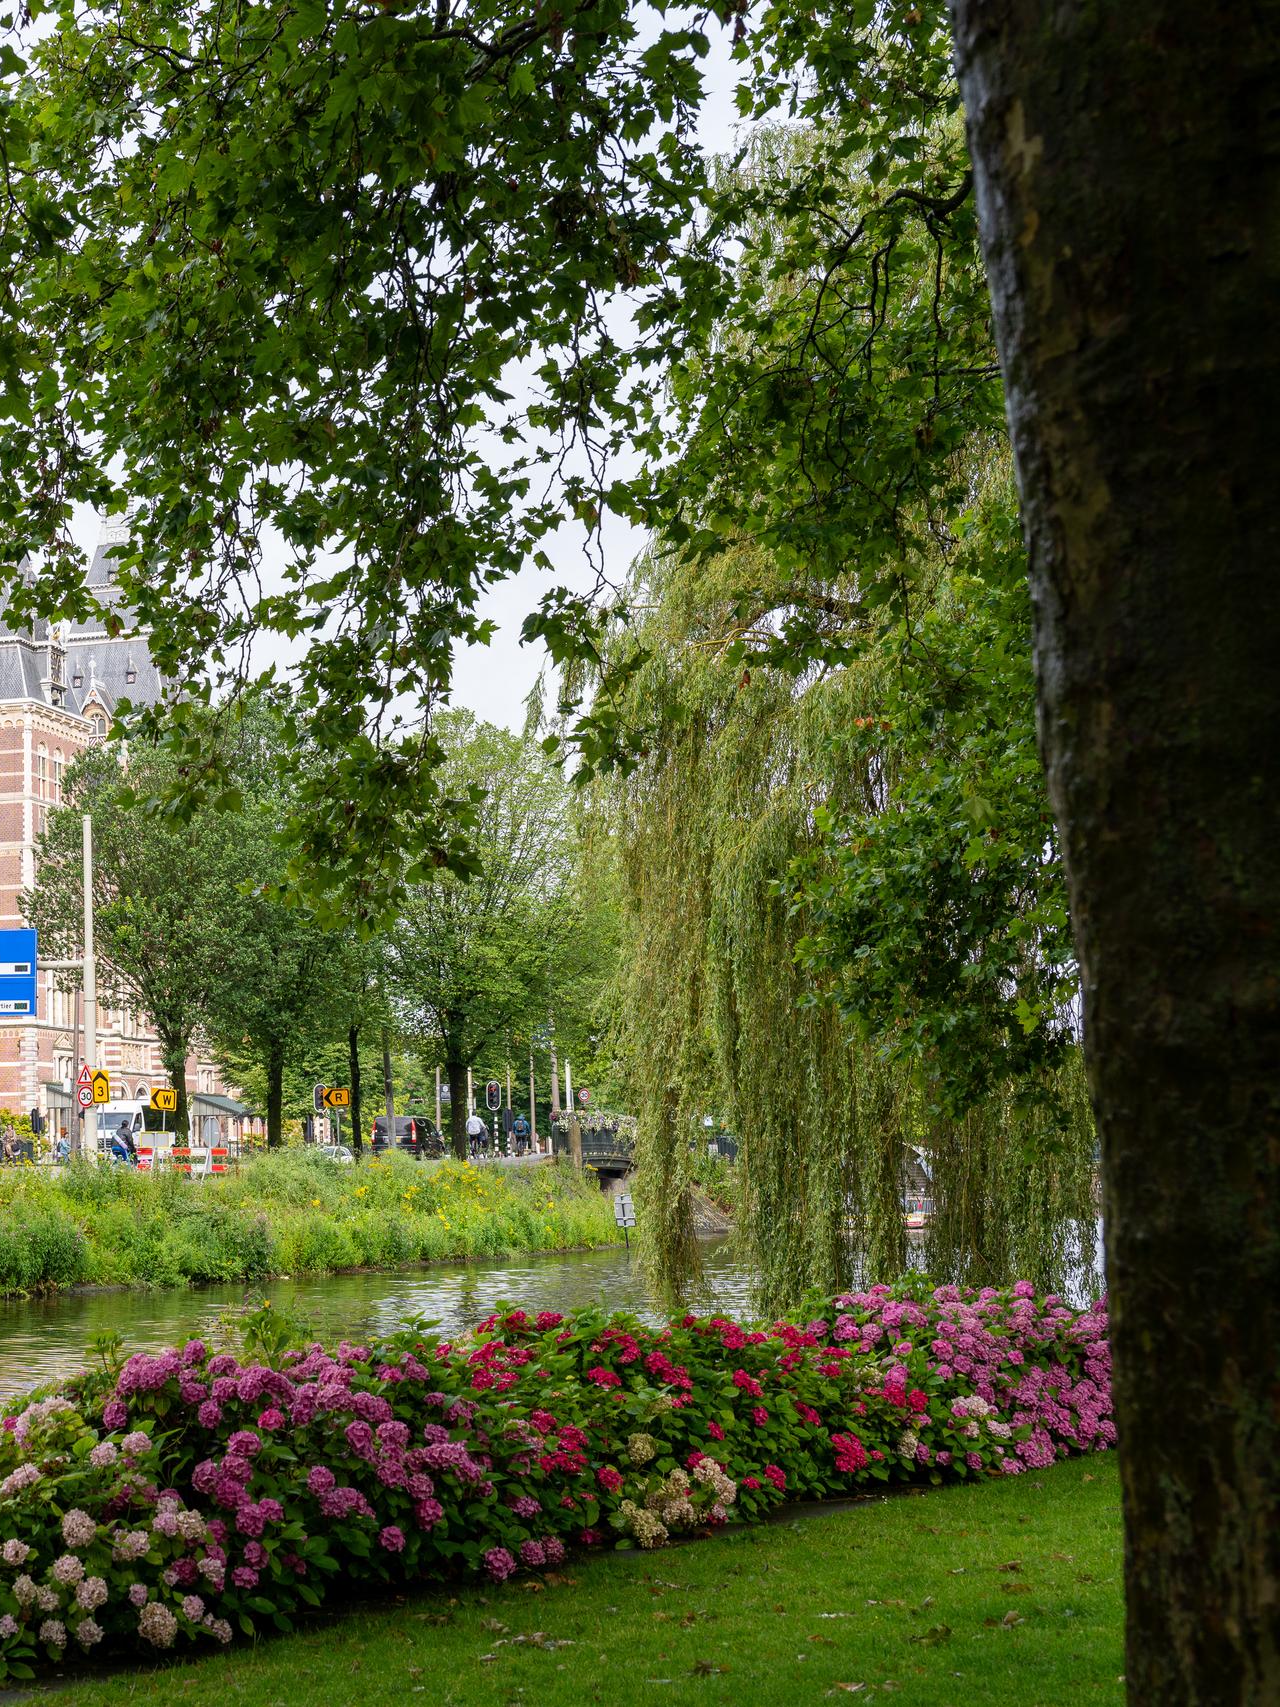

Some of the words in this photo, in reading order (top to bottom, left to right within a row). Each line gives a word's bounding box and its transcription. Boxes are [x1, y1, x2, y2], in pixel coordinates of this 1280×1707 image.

[97, 1087, 104, 1096] 3
[163, 1095, 171, 1105] W
[335, 1093, 342, 1101] R
